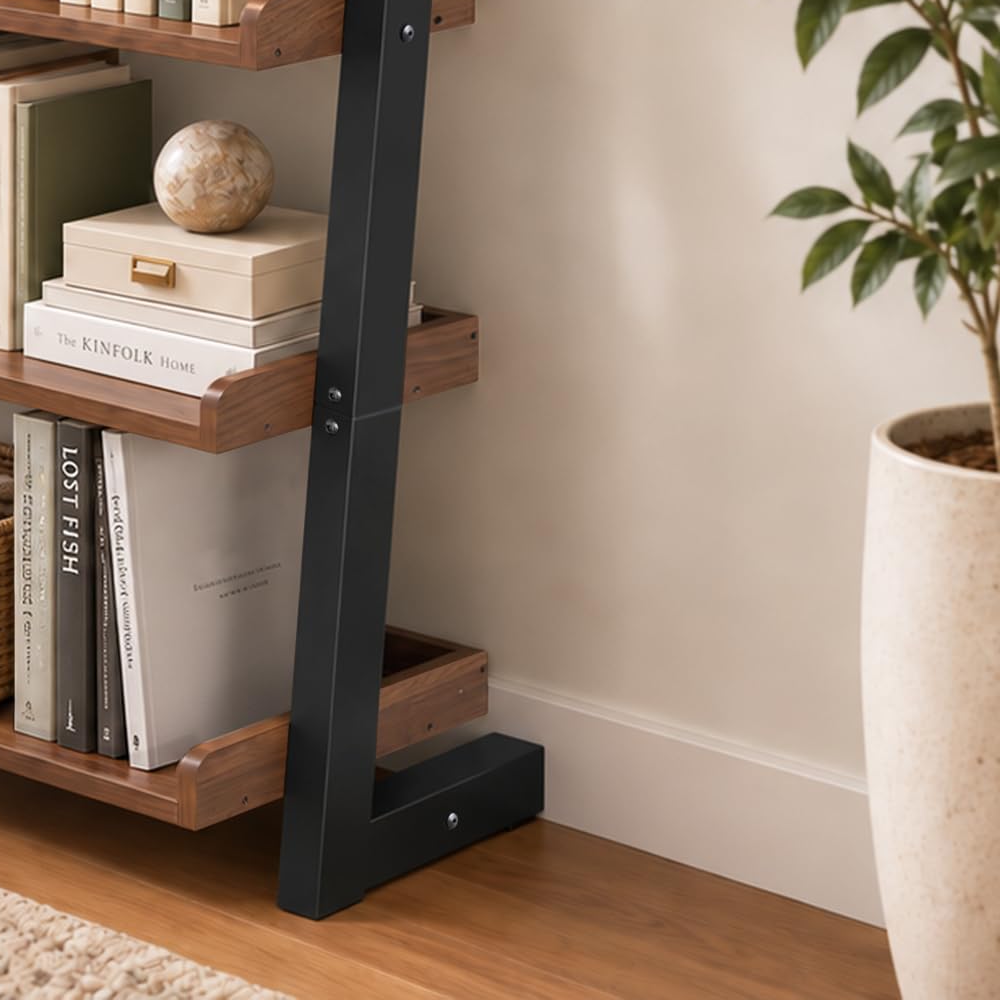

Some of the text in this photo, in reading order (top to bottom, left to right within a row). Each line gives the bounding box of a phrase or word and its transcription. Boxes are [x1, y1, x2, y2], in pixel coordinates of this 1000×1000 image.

[57, 332, 196, 375] The KINFOLK HOME
[61, 446, 79, 576] LOST FISH
